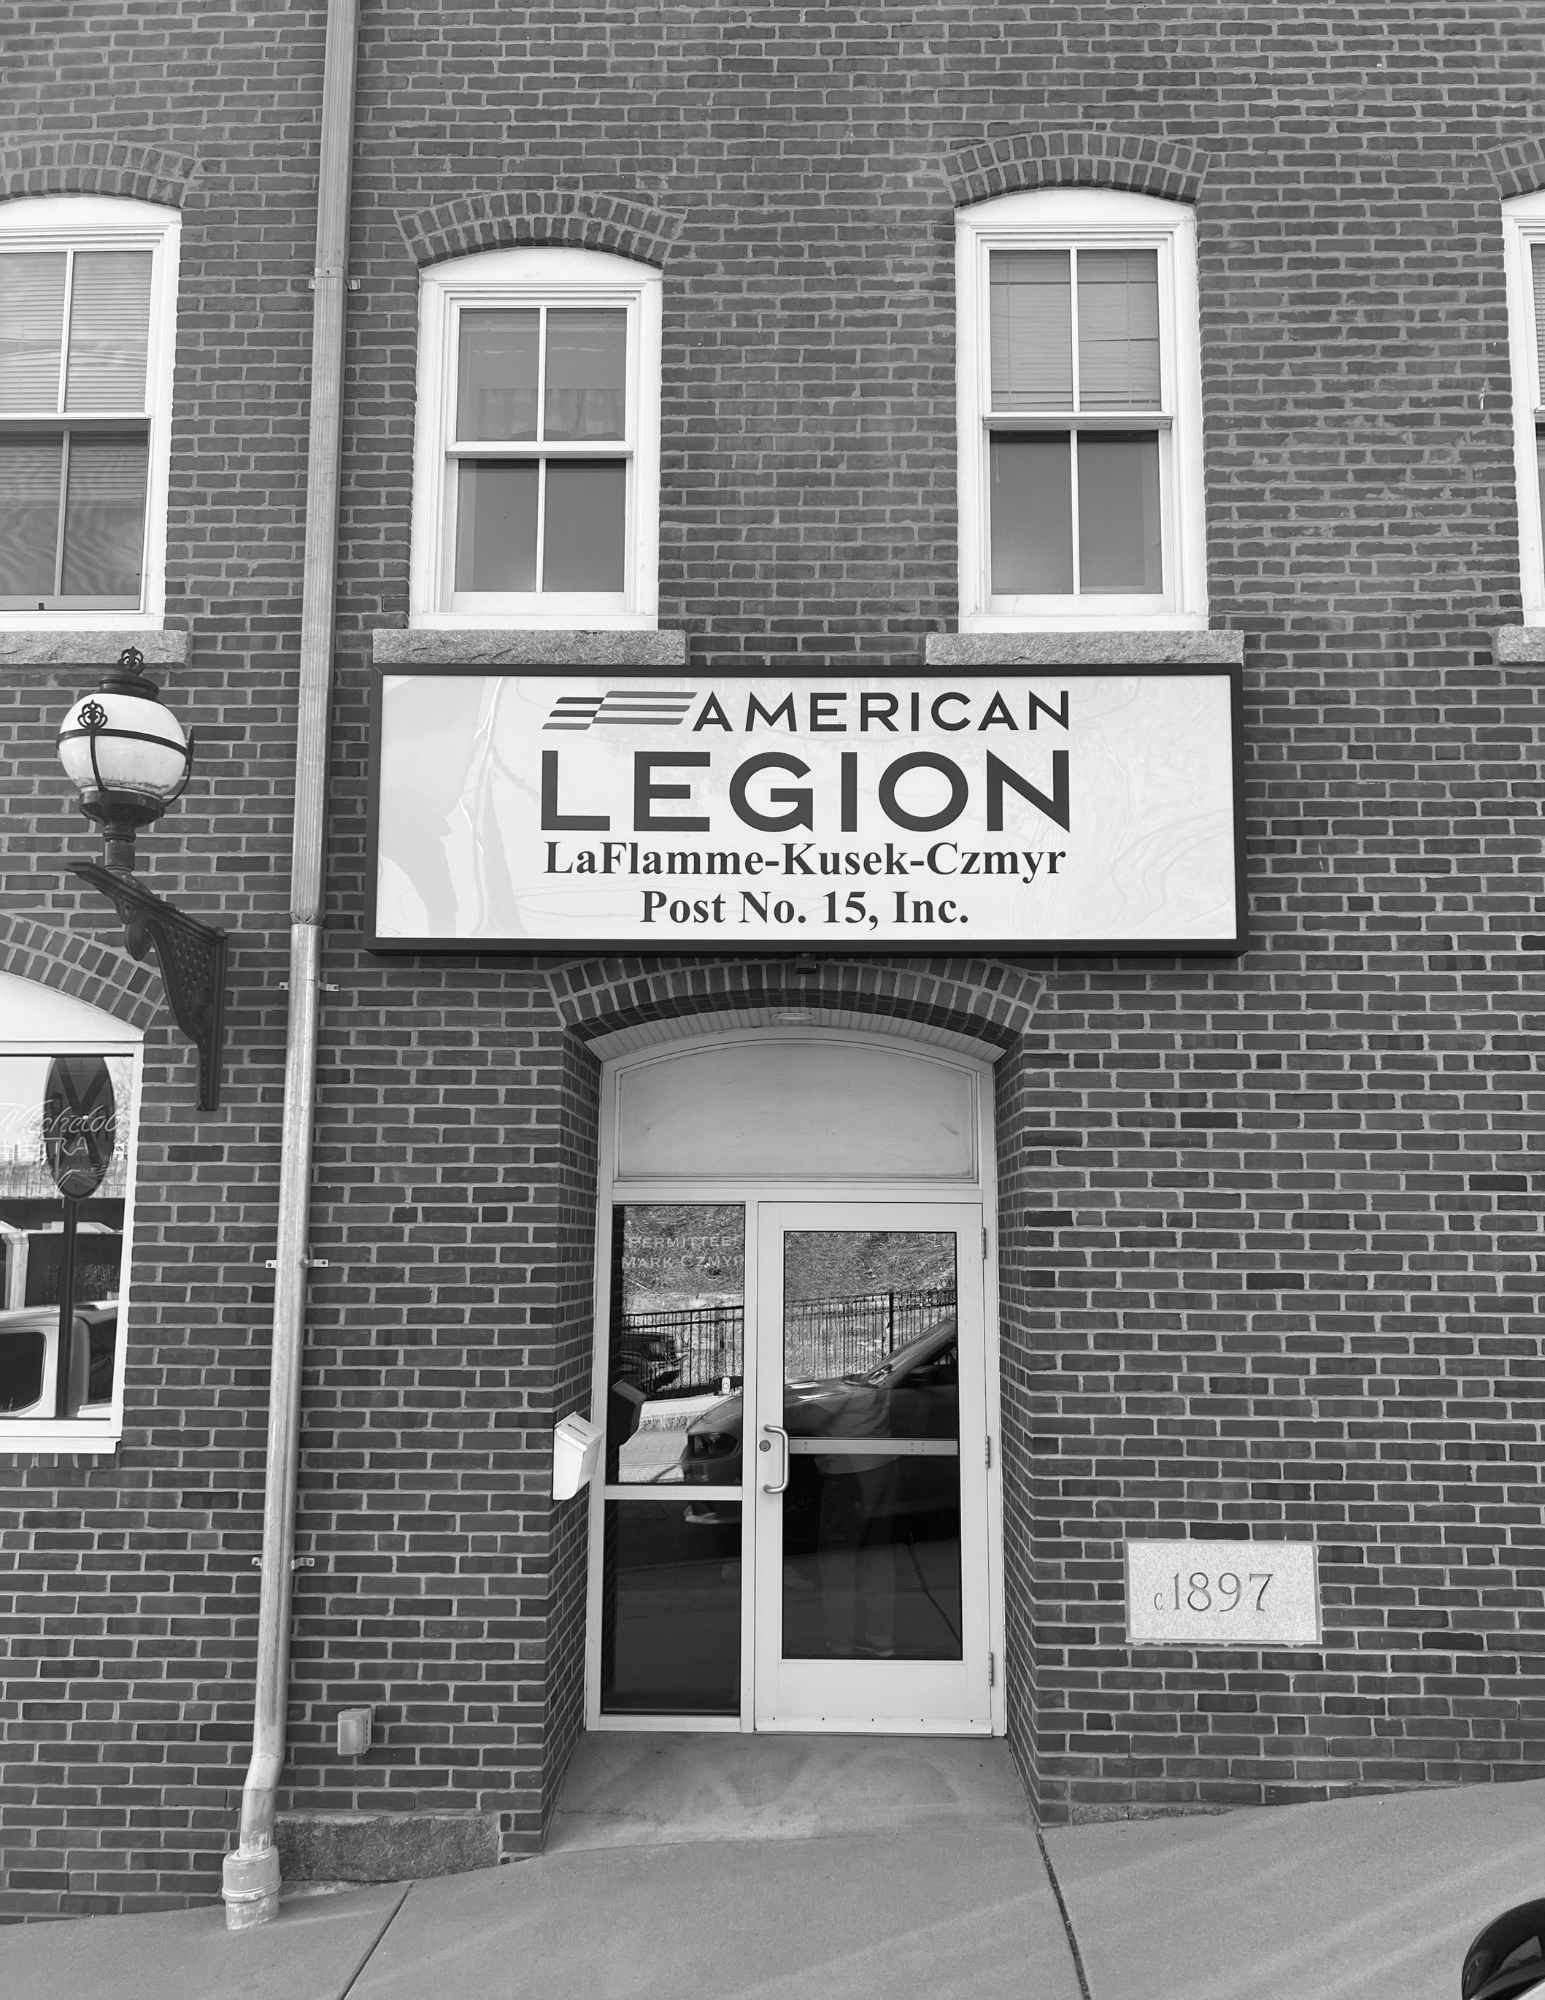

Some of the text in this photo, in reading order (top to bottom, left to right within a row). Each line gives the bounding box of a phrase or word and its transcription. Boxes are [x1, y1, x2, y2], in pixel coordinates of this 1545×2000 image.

[693, 691, 1069, 732] AMERICAN
[540, 750, 1070, 833] LEGION
[545, 842, 1066, 884] LaFlamme-Kusek-Czmyr
[641, 890, 969, 930] Post No. 15, Inc.
